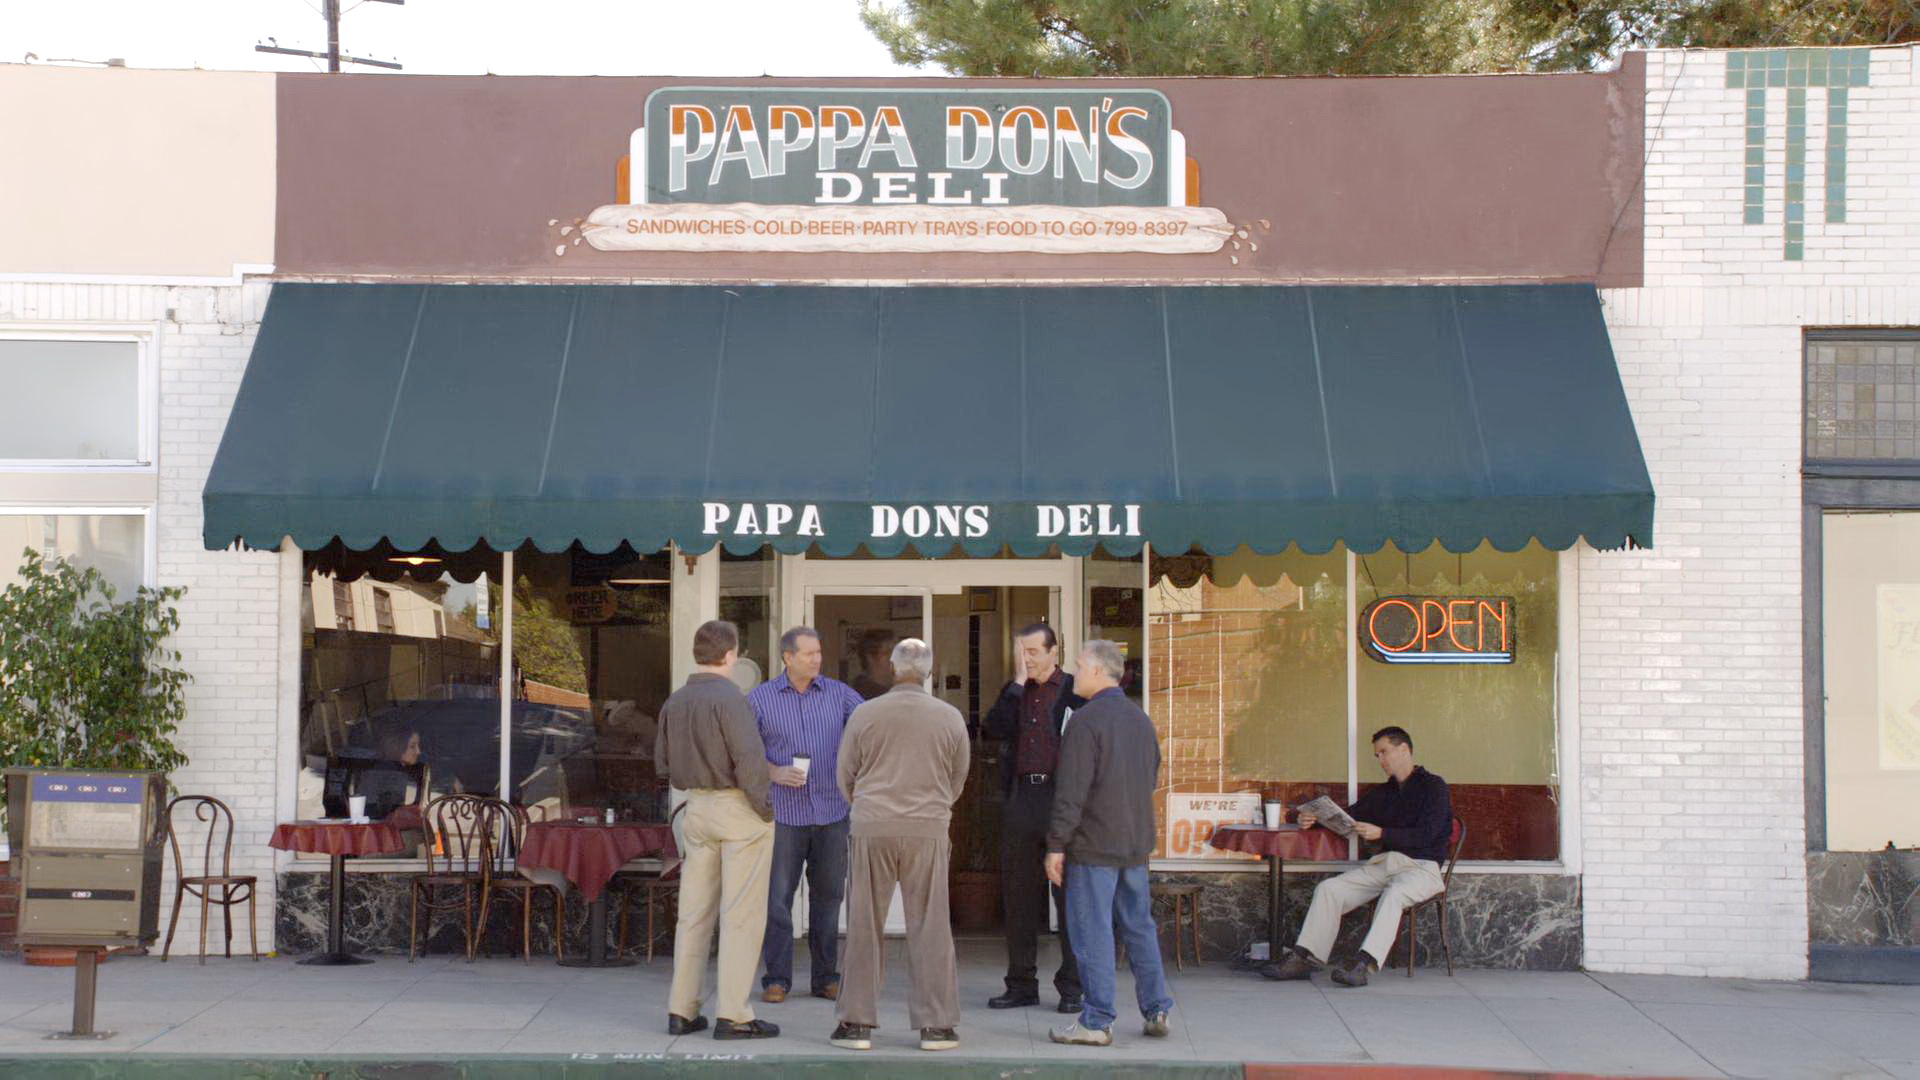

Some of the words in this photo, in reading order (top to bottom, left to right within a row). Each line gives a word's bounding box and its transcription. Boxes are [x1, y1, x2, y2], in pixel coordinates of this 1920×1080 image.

[667, 103, 917, 193] PAPPA
[945, 96, 1155, 190] DON'S
[815, 172, 1010, 205] DELI
[627, 219, 745, 235] SANDWICHES
[753, 219, 803, 235] COLD
[808, 220, 855, 235] BEER
[863, 220, 918, 235] PARTY
[924, 220, 978, 236] TRAYS
[986, 220, 1037, 236] FOOD
[1041, 220, 1065, 236] TO
[1069, 220, 1097, 236] GO
[702, 502, 825, 537] PAPA
[871, 504, 989, 539] DONS
[1036, 503, 1141, 537] DELI
[1369, 599, 1507, 652] OPEN
[1189, 799, 1238, 811] WE'RE
